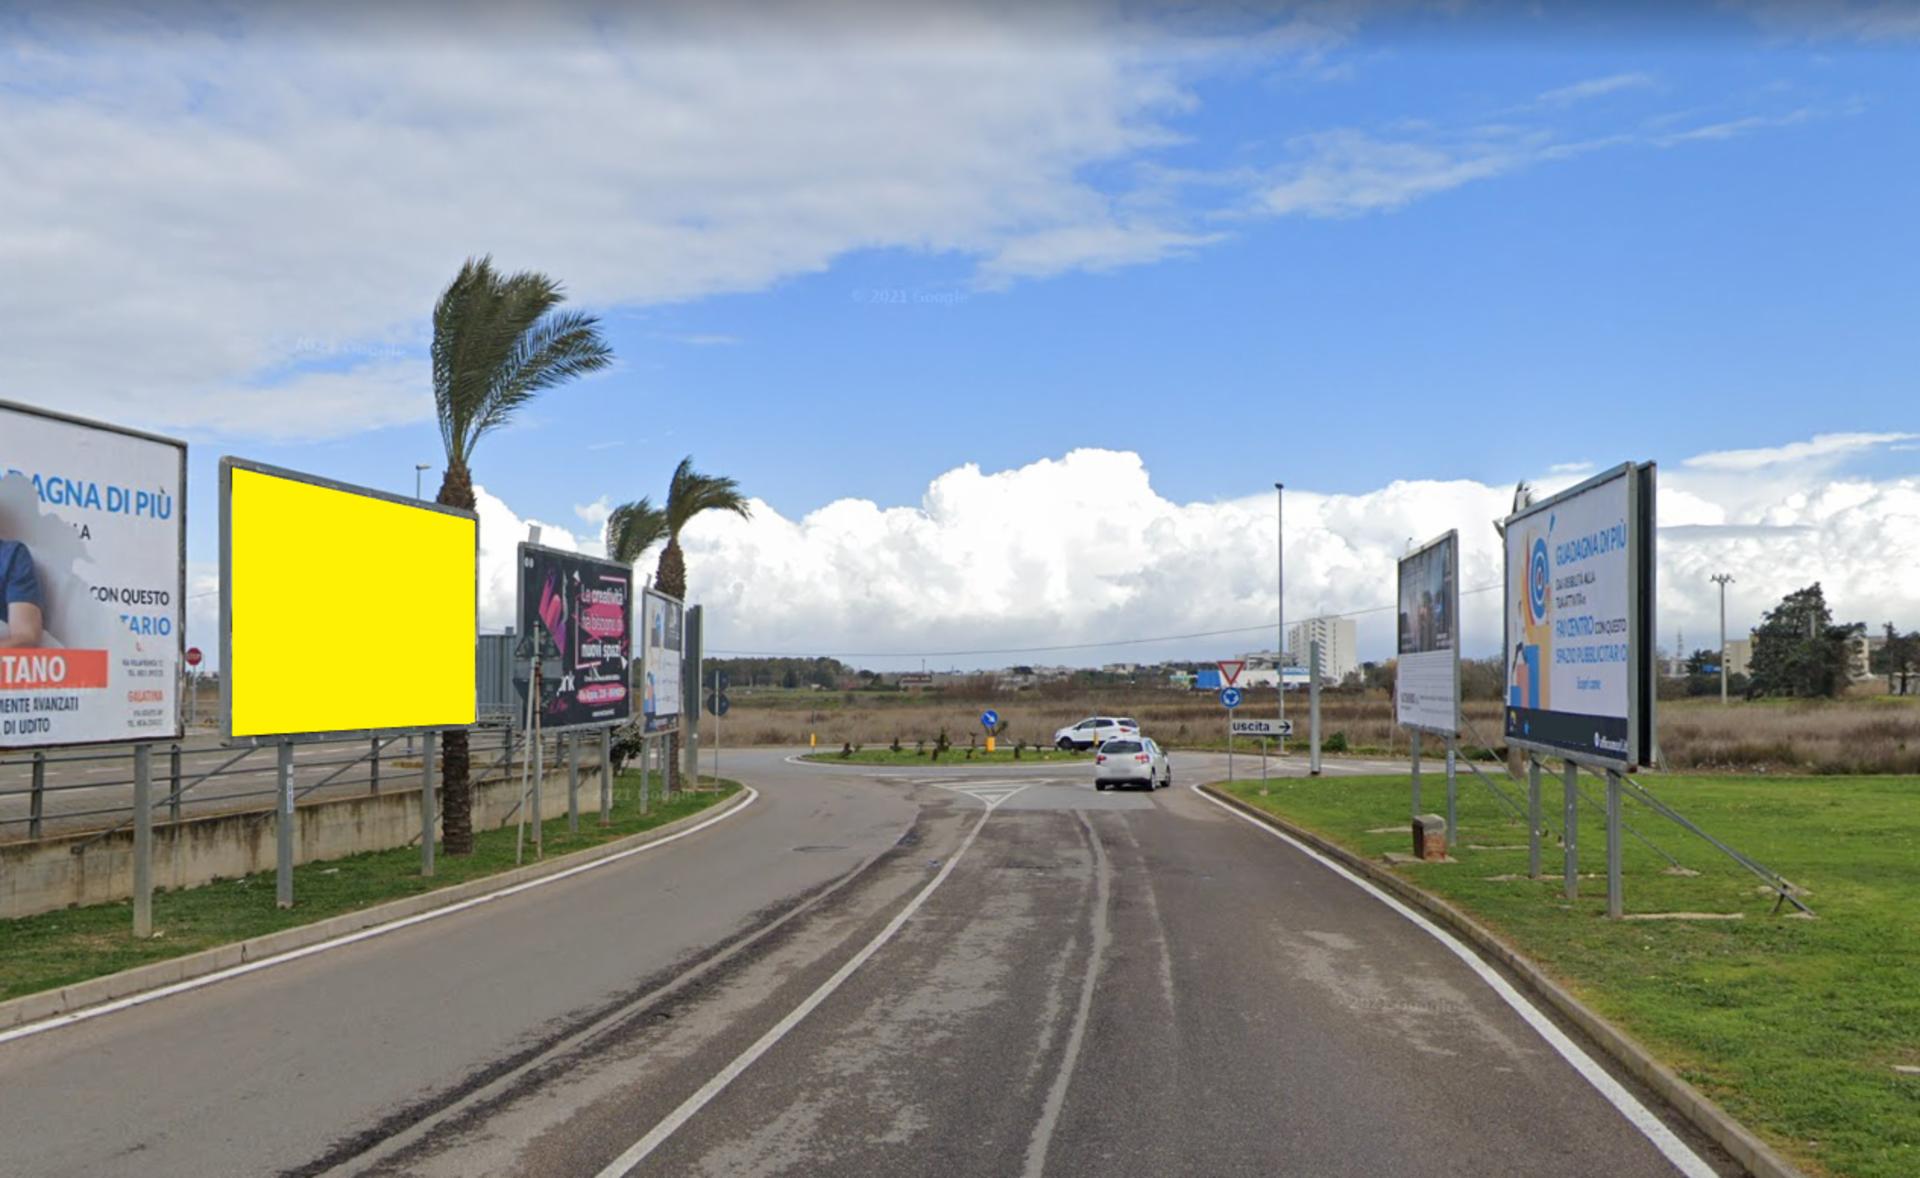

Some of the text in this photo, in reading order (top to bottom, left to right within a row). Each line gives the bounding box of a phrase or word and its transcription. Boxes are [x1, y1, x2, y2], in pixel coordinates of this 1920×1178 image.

[106, 485, 130, 515] DI
[136, 484, 172, 520] PIÙ
[1556, 532, 1599, 566] GUADAGNA
[120, 587, 170, 606] QUESTO
[1567, 615, 1594, 636] CENTRO
[33, 696, 79, 712] AVANZATI
[4, 717, 51, 735] DI UDITO
[1232, 720, 1270, 732] uscita
